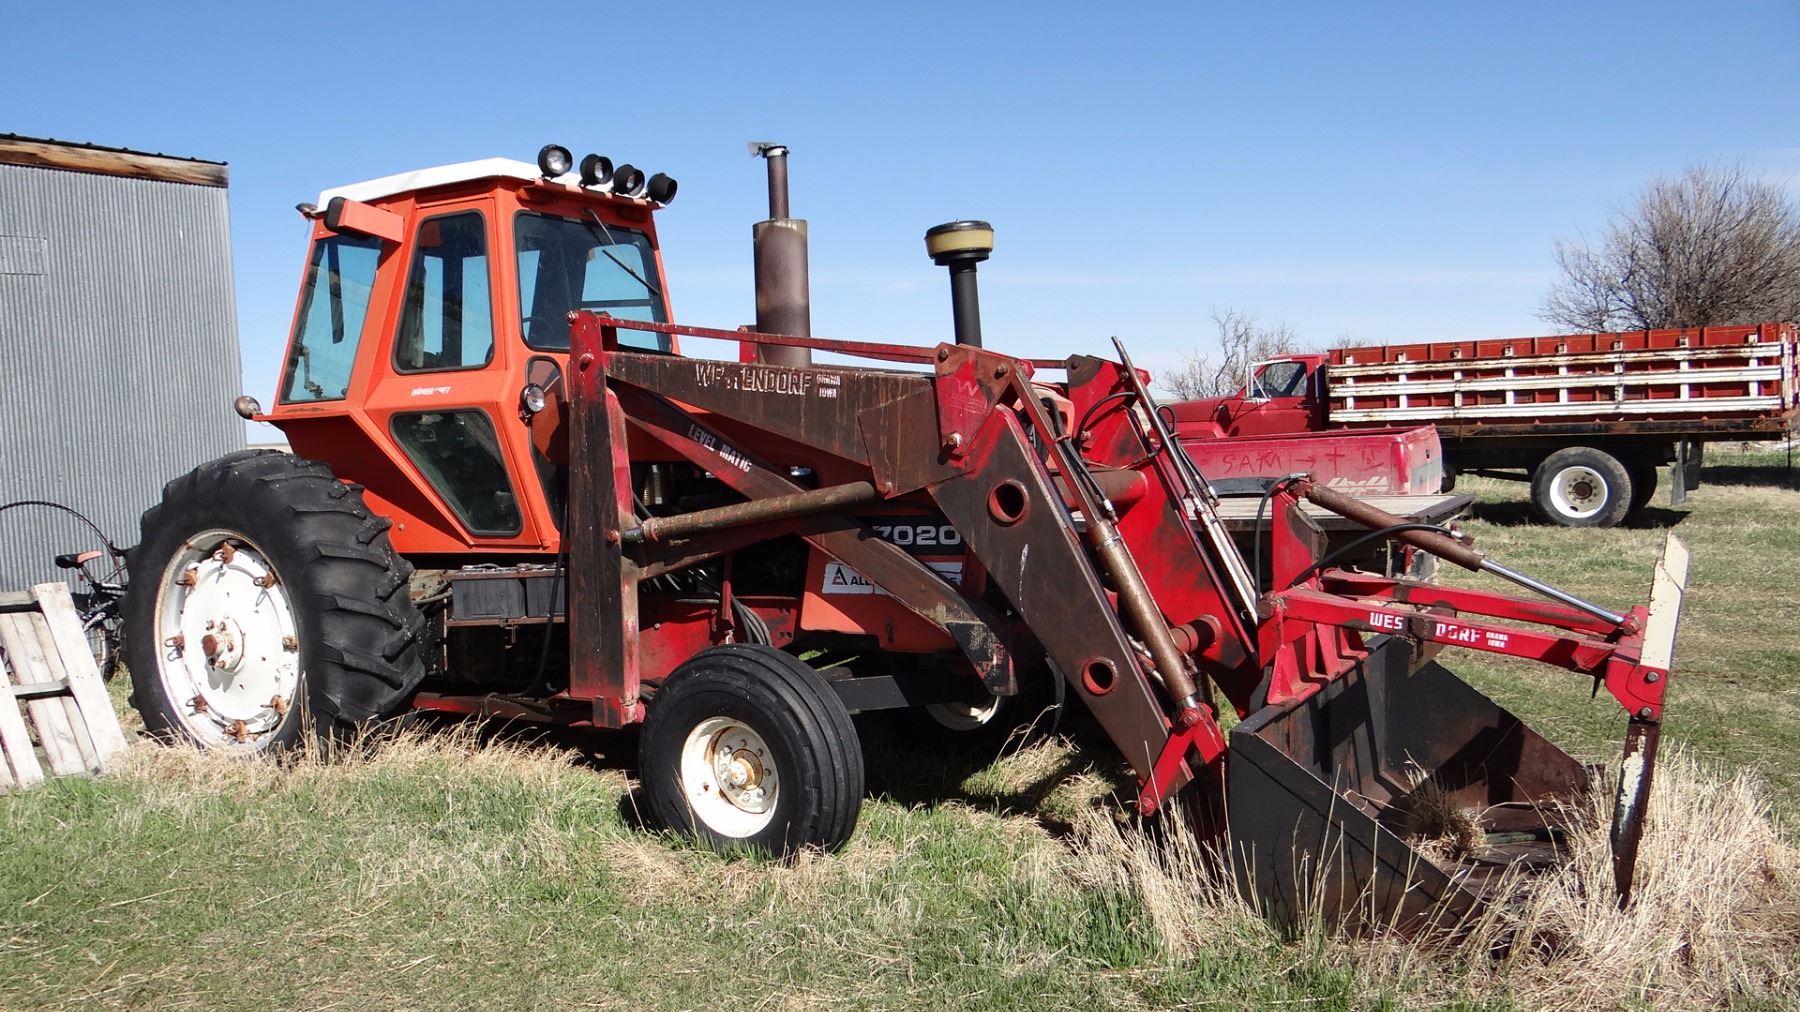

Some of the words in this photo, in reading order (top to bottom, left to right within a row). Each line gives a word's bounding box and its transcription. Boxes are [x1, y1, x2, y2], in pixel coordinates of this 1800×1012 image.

[688, 424, 715, 452] LEVEL
[719, 444, 753, 472] MATIC
[873, 525, 961, 545] 7020
